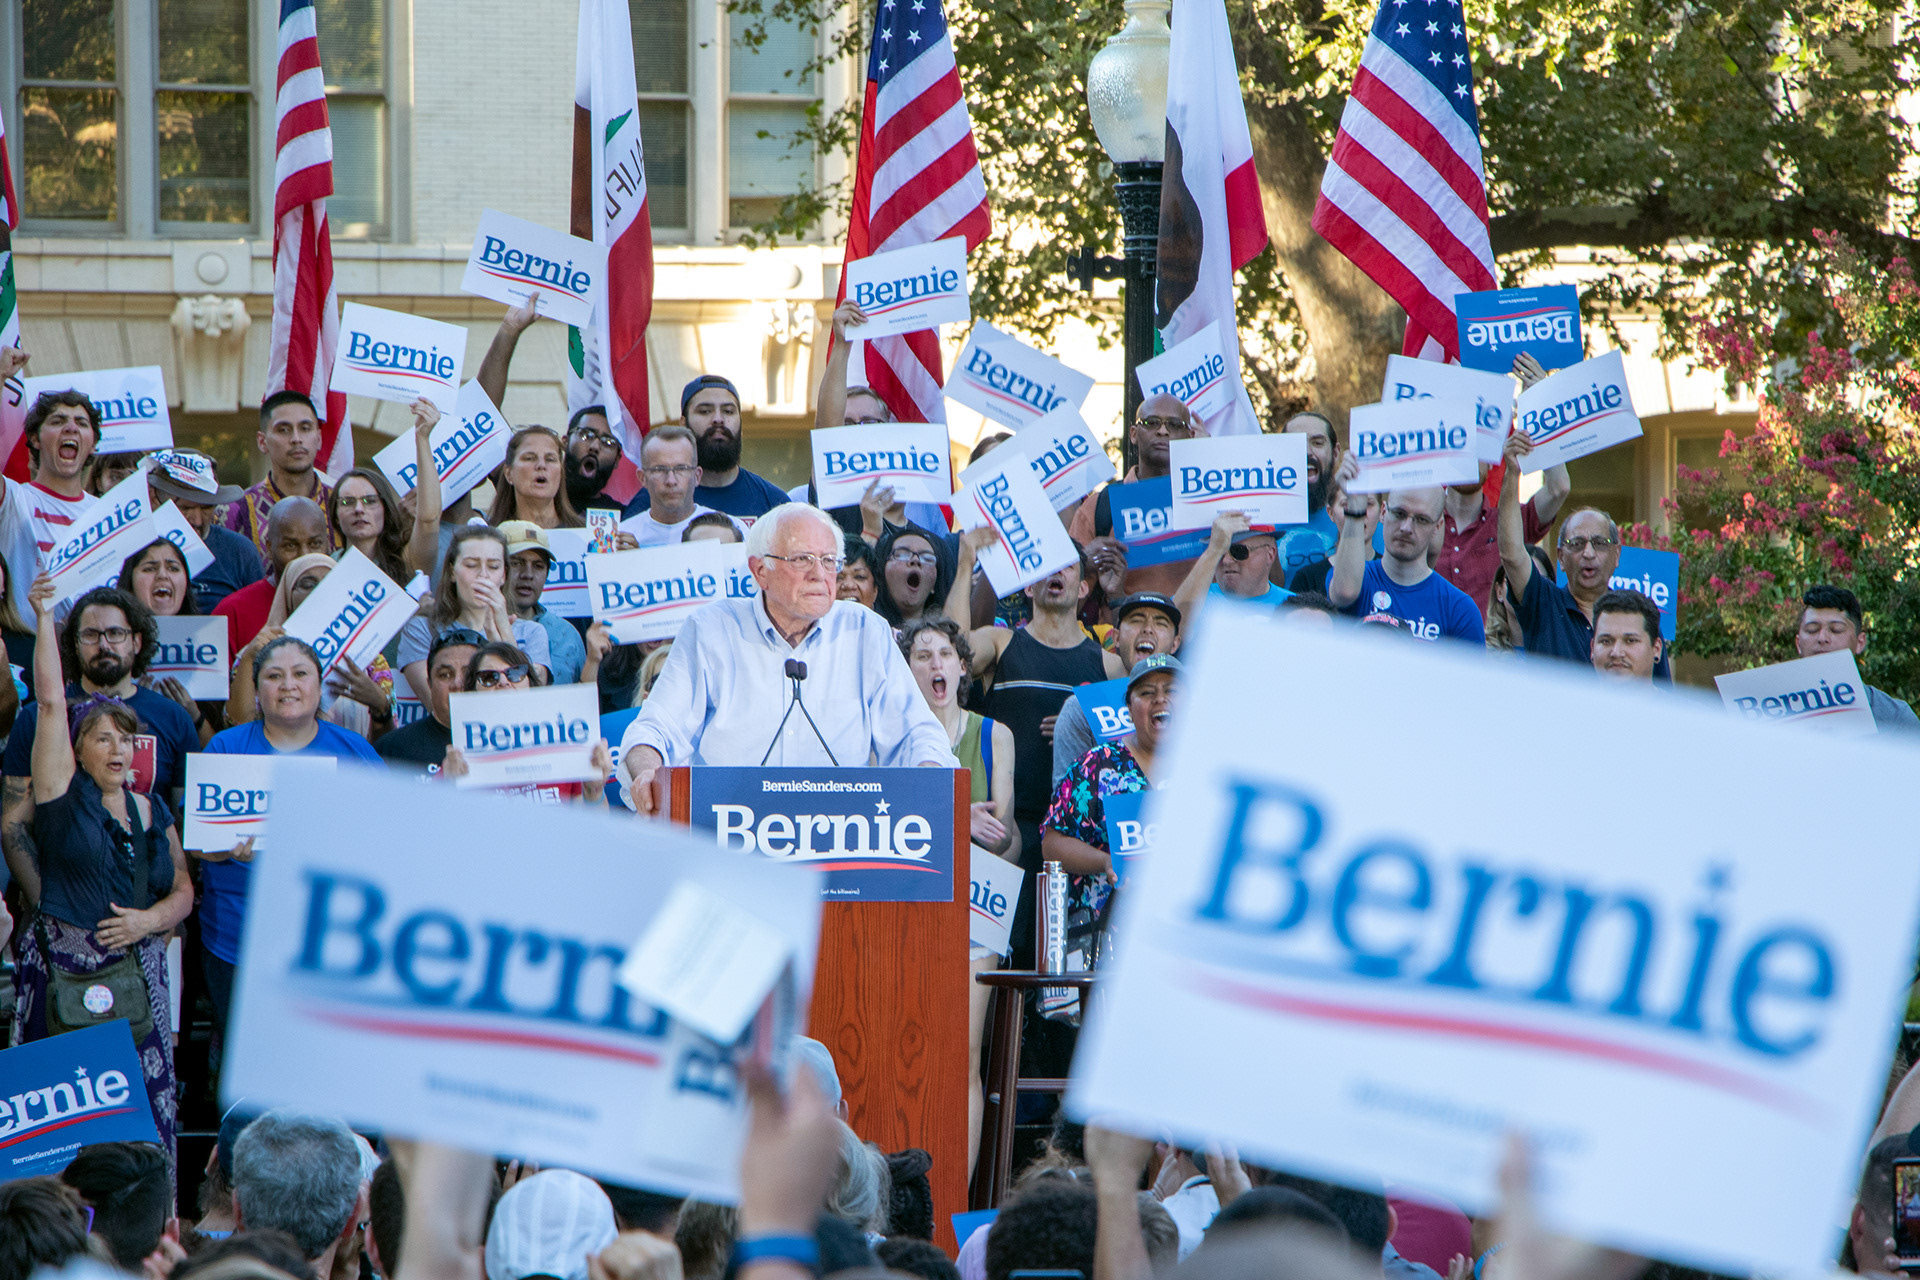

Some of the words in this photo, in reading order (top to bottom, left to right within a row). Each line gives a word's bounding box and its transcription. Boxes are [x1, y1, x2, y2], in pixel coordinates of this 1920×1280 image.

[479, 235, 591, 294] Bernie
[855, 265, 959, 308] Bernie
[346, 330, 455, 379] Bernie
[1467, 315, 1574, 352] Bernie
[92, 390, 157, 420] nie
[1522, 382, 1622, 436] Bernie
[1030, 434, 1089, 483] nie
[1357, 419, 1467, 458] Bernie
[823, 444, 939, 476] Bernie
[1180, 458, 1297, 494] Bernie
[49, 498, 142, 570] Bernie
[590, 515, 607, 527] US
[980, 471, 1043, 572] Bernie
[598, 568, 717, 610] Bernie
[312, 579, 386, 660] ernie
[150, 637, 218, 666] nie
[1733, 678, 1856, 720] Bernie
[462, 711, 590, 751] Bernie
[196, 783, 270, 815] Ber
[762, 780, 882, 793] BernieSanders.com
[711, 798, 933, 861] Bernie
[1048, 876, 1067, 963] Bernie
[1196, 771, 1838, 1062] Bernie
[288, 868, 670, 1038] Bern
[0, 1065, 130, 1132] rnie
[12, 1142, 82, 1165] BernieSanders.com
